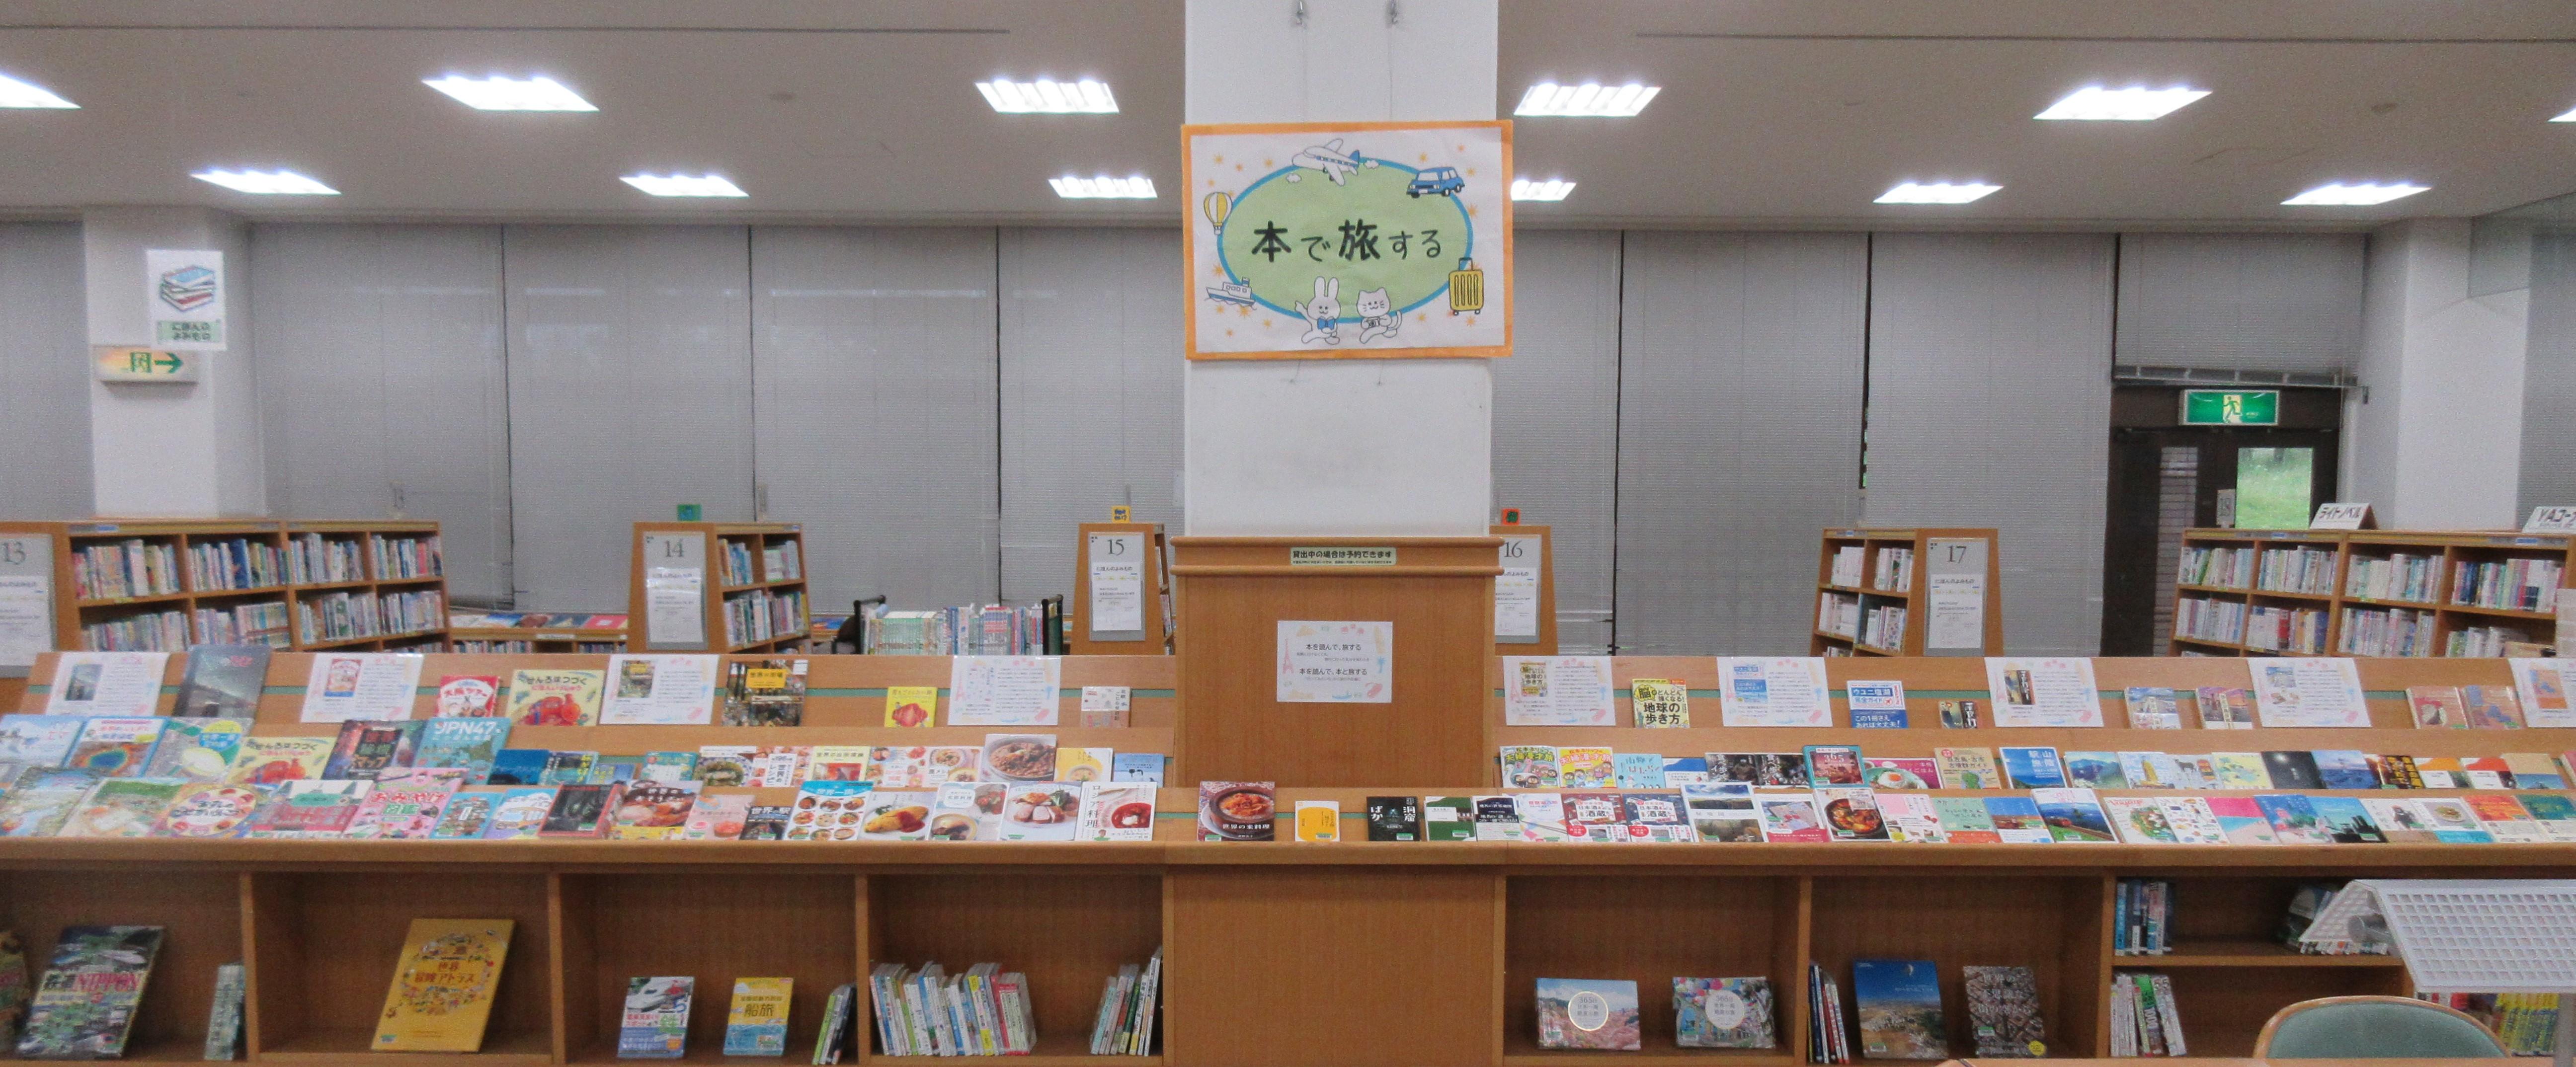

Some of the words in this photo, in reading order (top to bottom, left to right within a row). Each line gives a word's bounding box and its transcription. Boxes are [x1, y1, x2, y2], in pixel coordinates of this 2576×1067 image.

[1251, 219, 1442, 262] 本で旅する
[3, 540, 26, 565] 13
[665, 538, 684, 558] 14
[1107, 538, 1125, 556] 15
[1292, 550, 1391, 559] 貸出中の場合は予約できます
[1503, 540, 1523, 558] 16
[1947, 544, 1967, 563] 17
[1644, 702, 1680, 712] 地球の
[1645, 713, 1681, 724] 歩き方
[1824, 752, 1845, 762] 365
[1085, 785, 1100, 828] ロシア料理
[1370, 806, 1383, 821] ばか
[1403, 806, 1416, 822] 洞窟
[744, 1003, 775, 1017] 船旅
